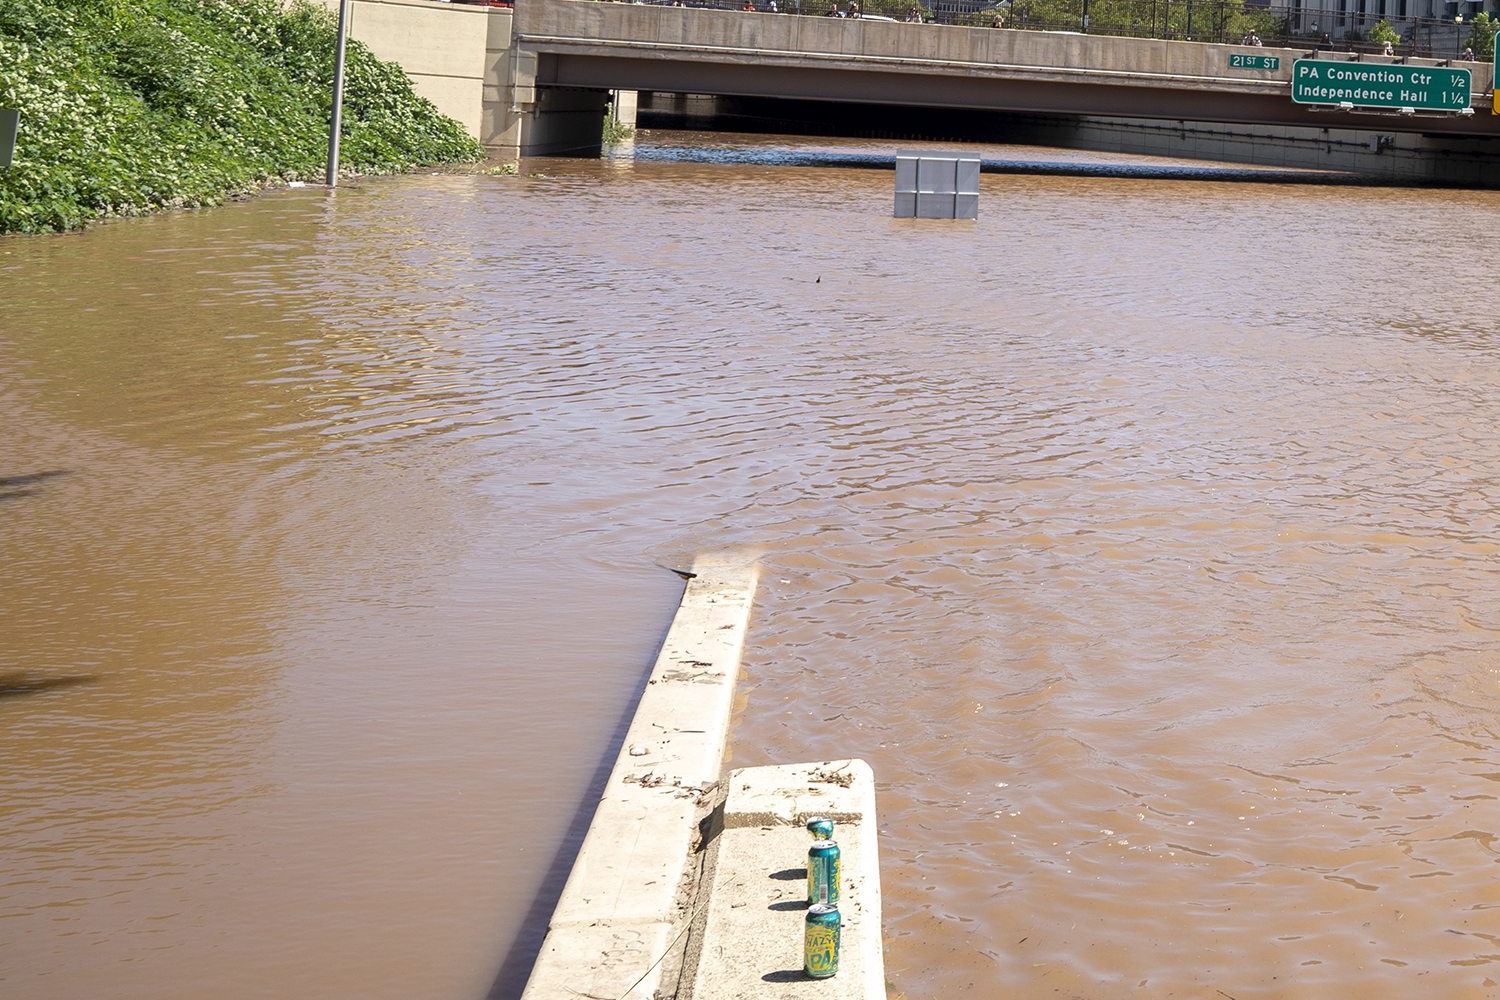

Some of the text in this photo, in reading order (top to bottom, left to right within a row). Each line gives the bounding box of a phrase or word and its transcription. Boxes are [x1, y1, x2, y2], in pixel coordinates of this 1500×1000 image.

[1263, 59, 1277, 69] ST
[1300, 67, 1319, 79] PA
[1327, 68, 1403, 83] Convention
[1411, 73, 1432, 85] Ctr
[1299, 84, 1393, 101] Independence
[1400, 90, 1427, 102] Hall
[806, 936, 833, 947] HAZY
